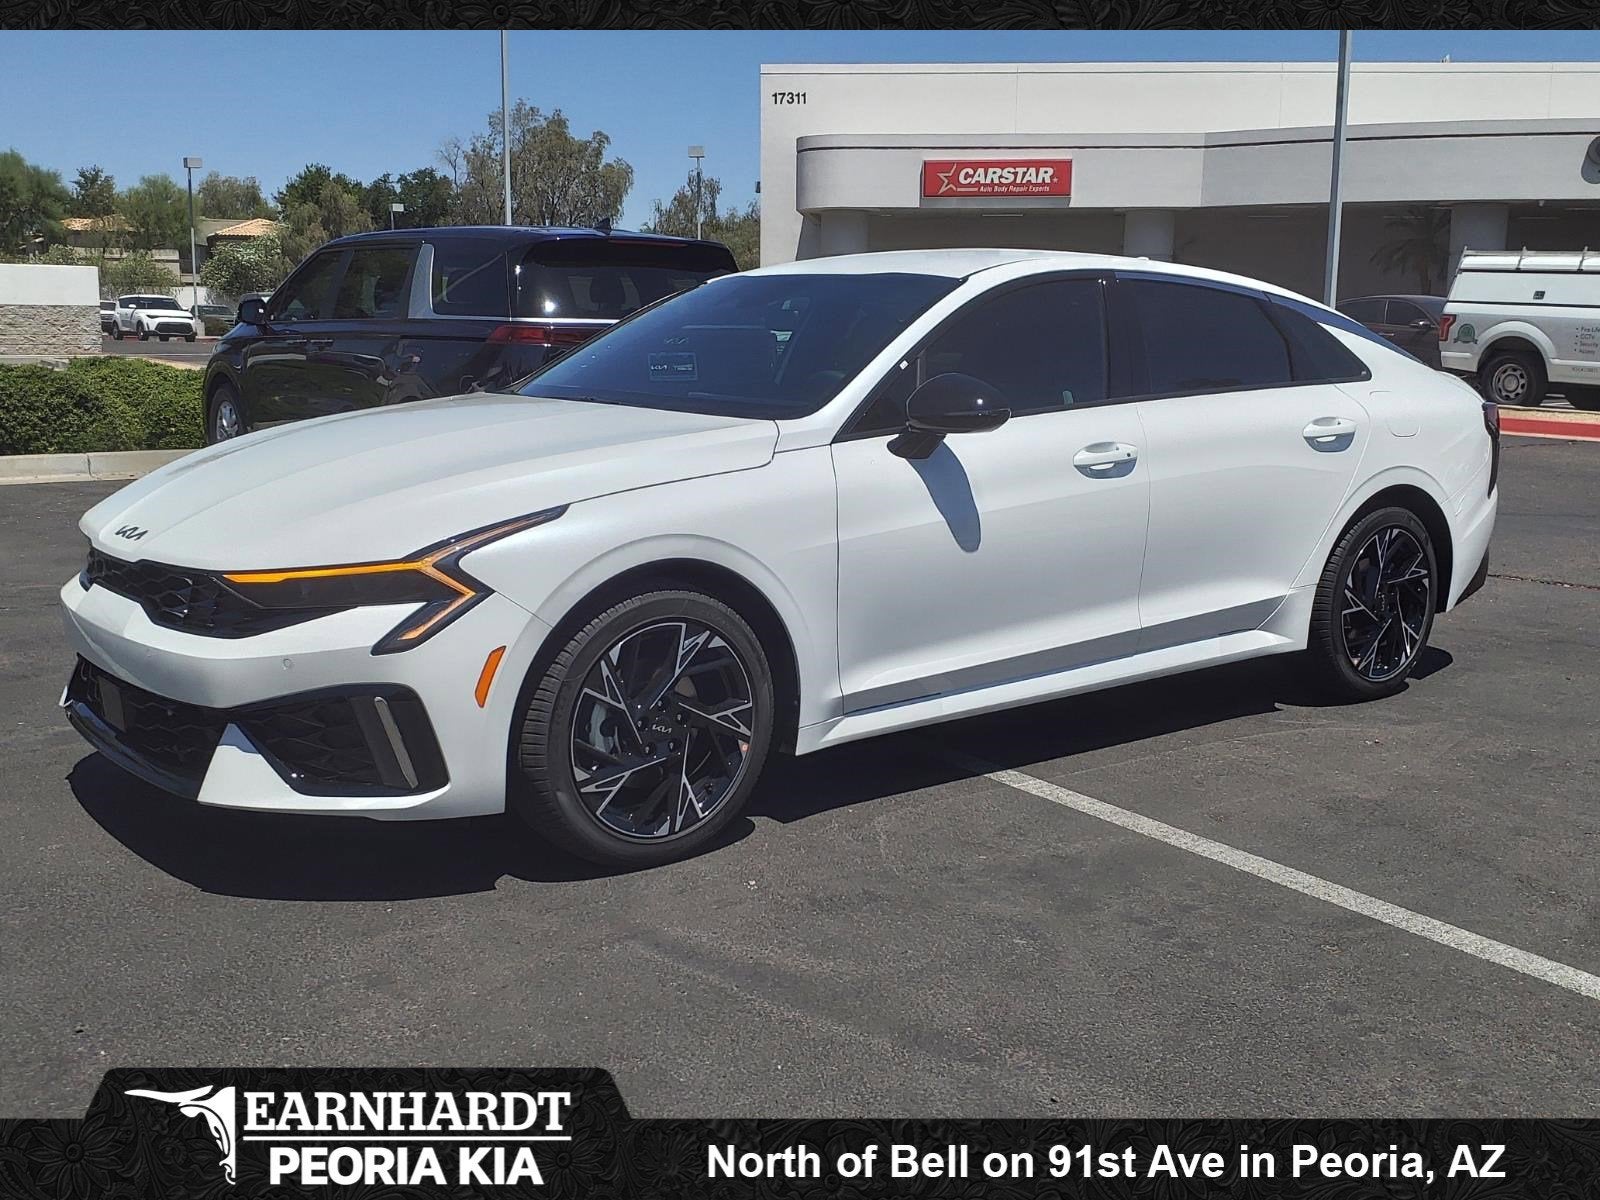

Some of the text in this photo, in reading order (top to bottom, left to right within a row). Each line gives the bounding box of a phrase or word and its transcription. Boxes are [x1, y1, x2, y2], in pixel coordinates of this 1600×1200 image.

[772, 92, 807, 105] 17311
[958, 167, 1054, 184] CARSTAR
[994, 186, 1008, 194] Body
[1009, 186, 1029, 194] Repair
[1029, 185, 1050, 193] Experts
[115, 525, 149, 541] KIA
[652, 724, 672, 734] KIA
